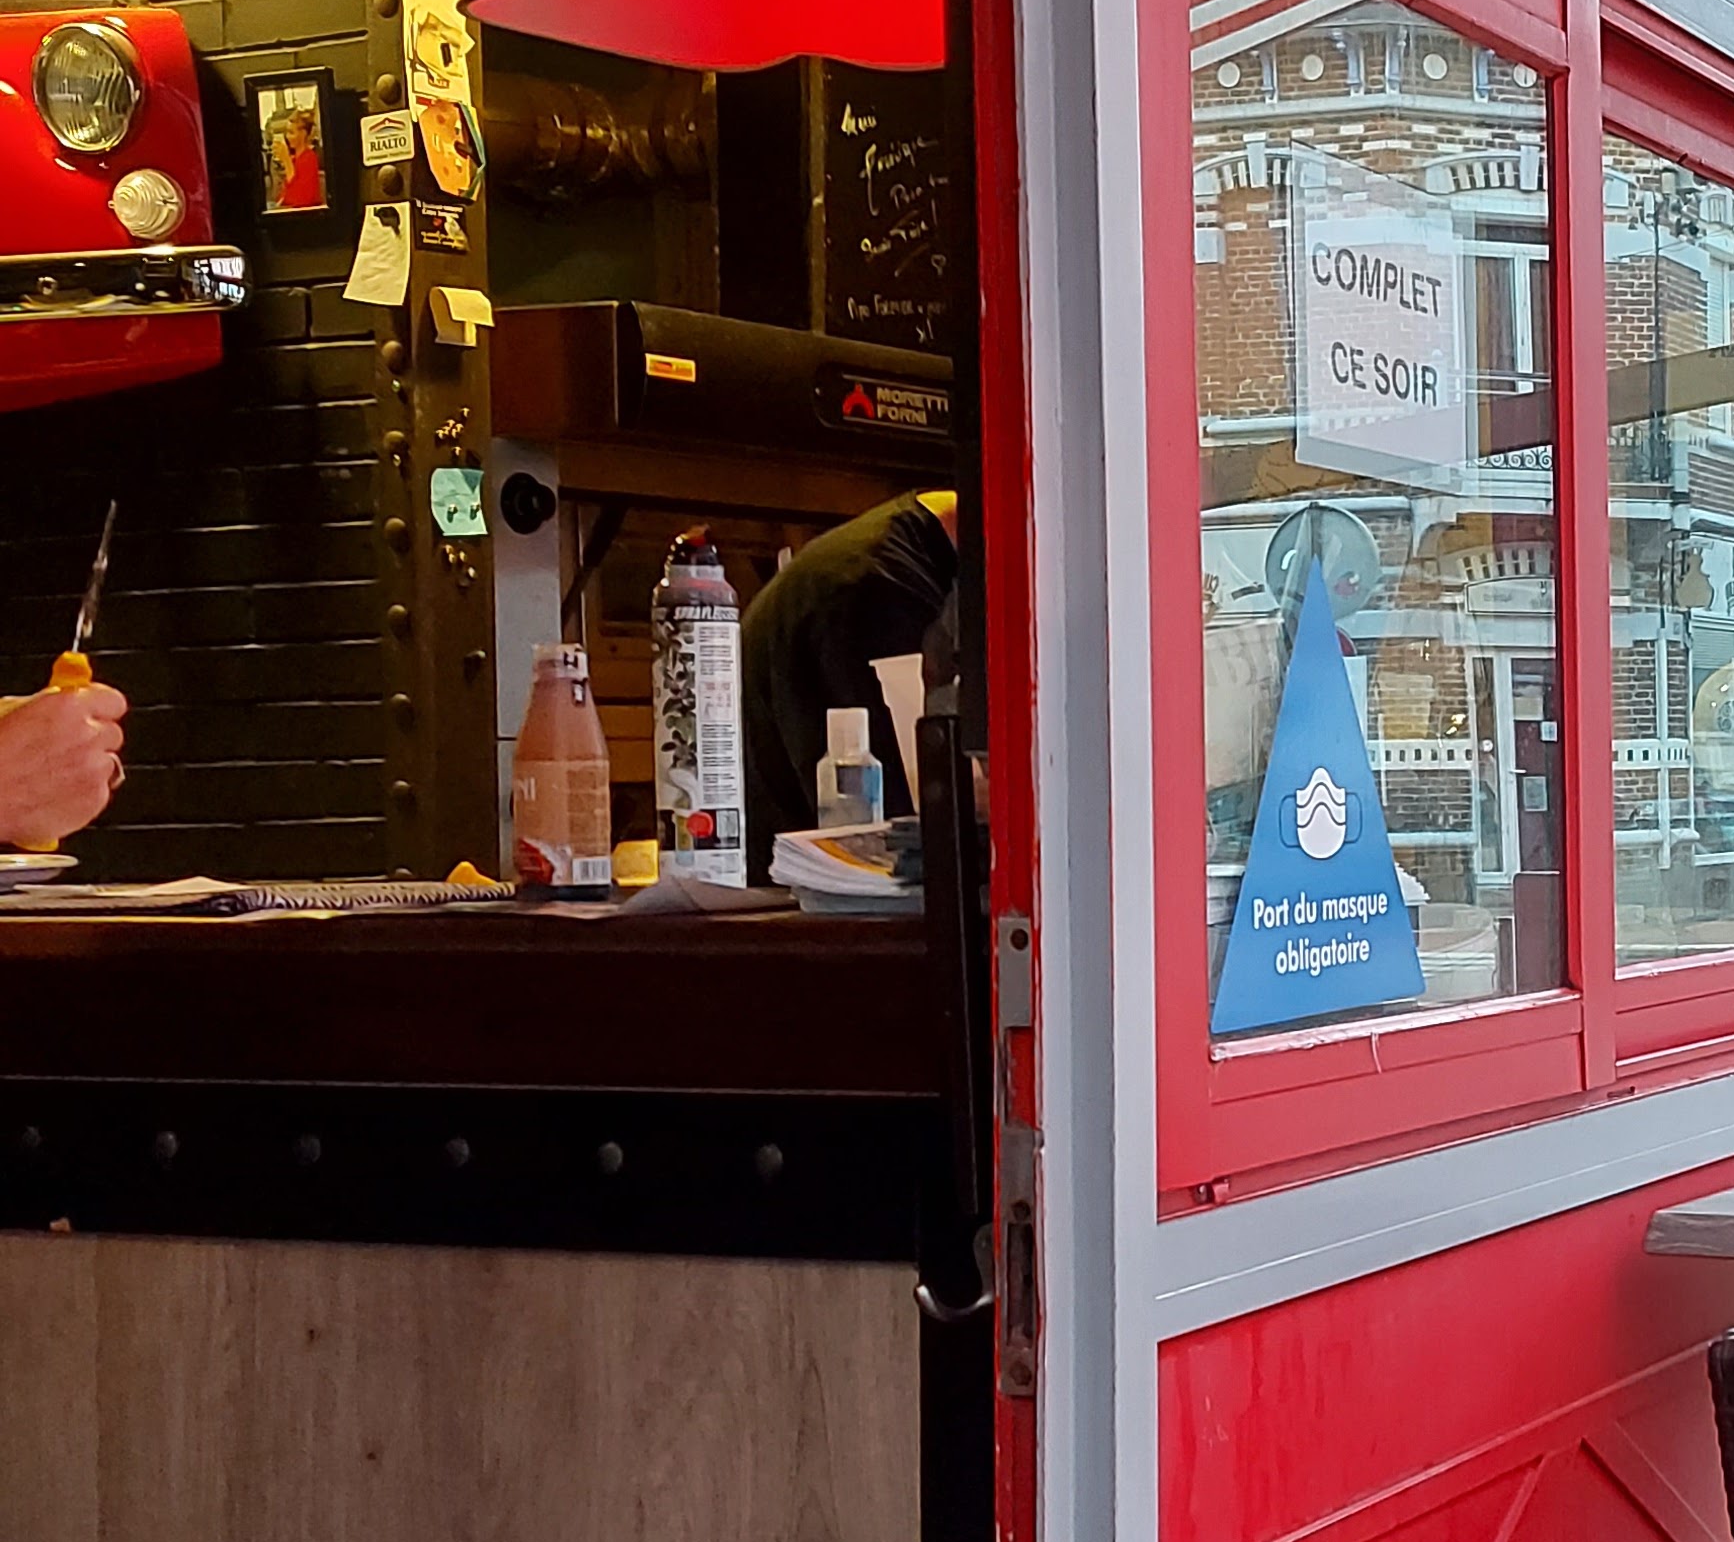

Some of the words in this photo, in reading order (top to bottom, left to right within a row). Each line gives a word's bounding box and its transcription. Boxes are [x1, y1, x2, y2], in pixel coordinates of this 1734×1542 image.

[369, 136, 407, 153] RIALTO
[1311, 241, 1442, 319] COMPLET
[1330, 341, 1366, 390] CE
[1374, 352, 1438, 407] SOIR
[876, 386, 949, 413] MORETTI
[876, 403, 928, 425] FORNI
[1252, 897, 1290, 930] Port
[1293, 891, 1317, 925] du
[1321, 892, 1388, 924] masque
[1274, 932, 1370, 977] obligatoire
